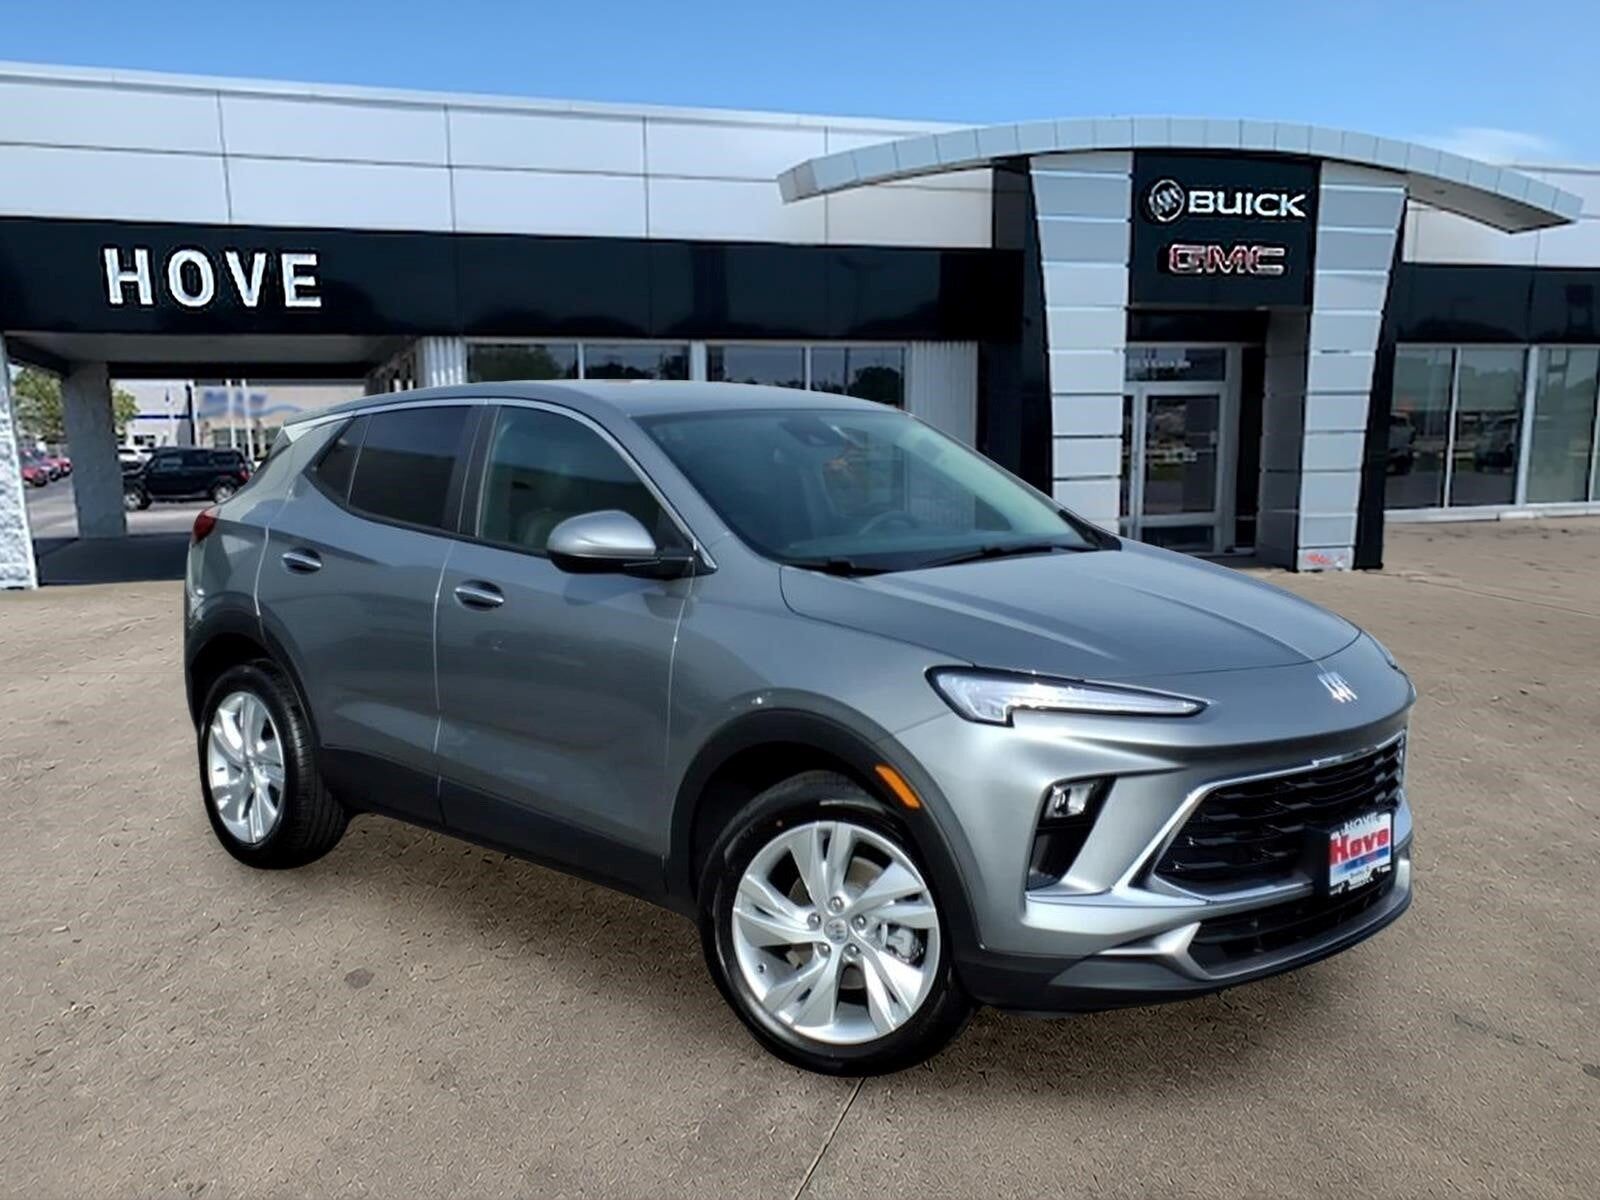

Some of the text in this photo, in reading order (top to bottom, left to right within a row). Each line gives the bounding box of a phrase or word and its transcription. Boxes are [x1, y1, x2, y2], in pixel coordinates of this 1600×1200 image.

[1188, 190, 1306, 217] BUICK
[1168, 243, 1286, 275] GMC
[103, 247, 322, 307] HOVE
